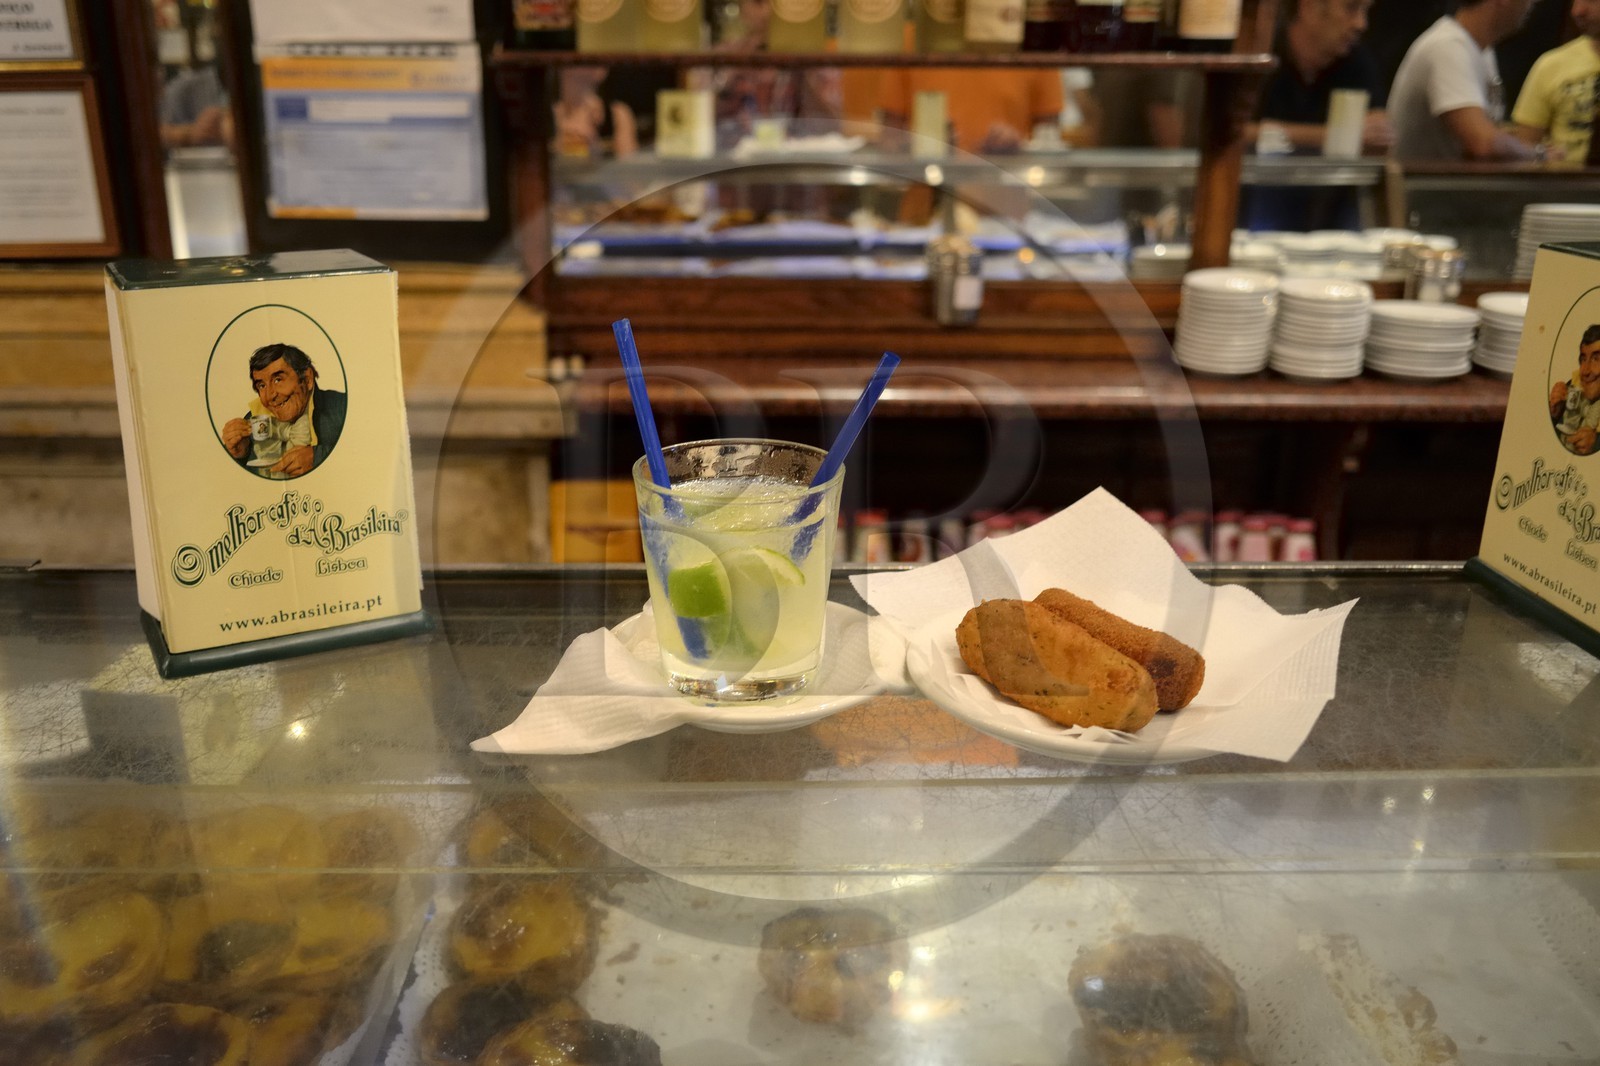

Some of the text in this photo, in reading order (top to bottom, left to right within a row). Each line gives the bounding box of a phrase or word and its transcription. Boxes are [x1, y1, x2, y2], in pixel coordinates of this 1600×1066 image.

[1496, 474, 1513, 511] O
[1513, 458, 1553, 509] melhor
[172, 544, 206, 587] O
[206, 504, 267, 576] melhor
[267, 491, 299, 529] café
[313, 499, 323, 514] o
[321, 507, 401, 555] Brasileira
[1519, 516, 1598, 571] Chiado Lisboa
[229, 557, 368, 588] Chiado Lisboa
[1502, 552, 1598, 615] www.abrasileira.pt
[219, 595, 383, 632] www.abrasileira.pt
